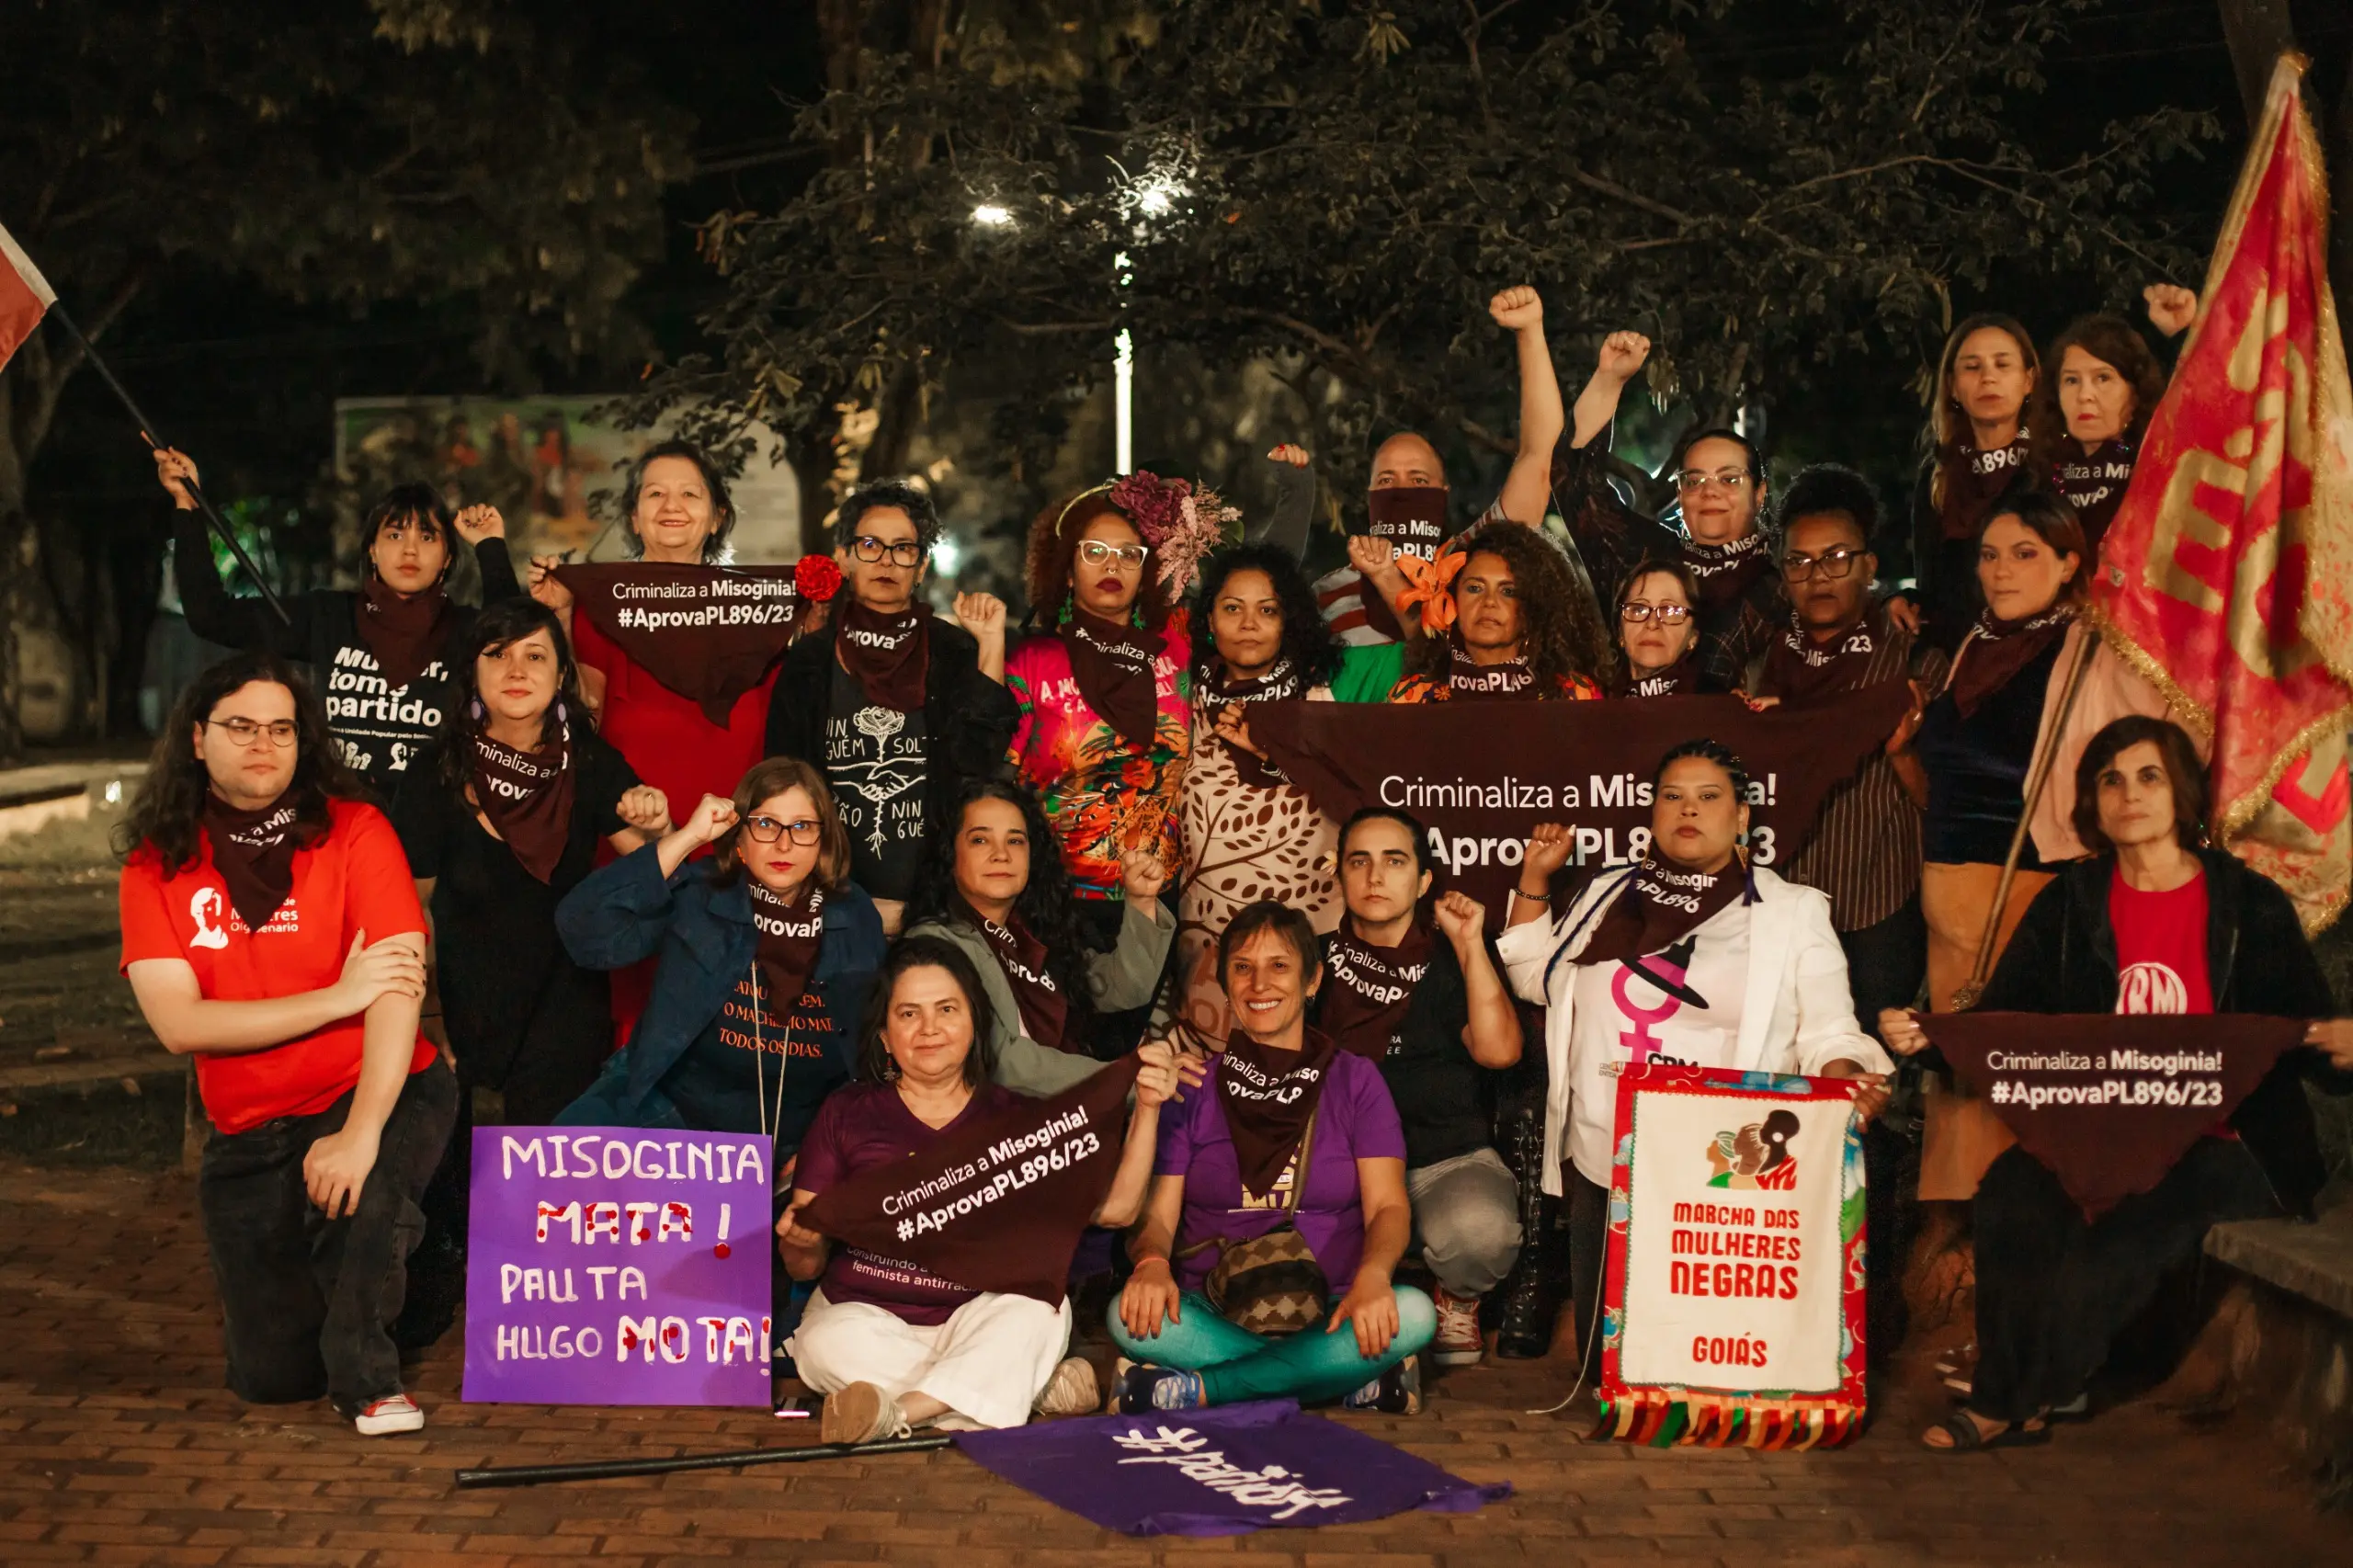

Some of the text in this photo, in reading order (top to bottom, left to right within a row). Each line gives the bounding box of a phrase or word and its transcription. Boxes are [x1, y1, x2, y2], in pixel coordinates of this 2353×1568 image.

[2105, 462, 2130, 479] Mi
[1398, 523, 1407, 534] a
[1722, 534, 1758, 555] Miso
[612, 579, 797, 600] Criminaliza a Misoginia!
[618, 604, 795, 632] #AprovaPL896/23
[326, 696, 442, 727] partido
[1380, 773, 1777, 809] Criminaliza a Misa!
[264, 808, 296, 830] Mis
[723, 1002, 734, 1017] O
[720, 1028, 766, 1051] TODOS
[1987, 1049, 2222, 1076] Criminaliza a Misoginia!
[1991, 1080, 2223, 1110] #AprovaPL896/23
[502, 1135, 765, 1185] MISOGINIA
[882, 1105, 1089, 1215] Criminaliza a Misoginia!
[896, 1131, 1100, 1242] #AprovaPL896/23
[536, 1200, 693, 1245] MATA
[1673, 1202, 1800, 1230] MARCHA DAS
[1671, 1229, 1802, 1262] MULHERES
[852, 1260, 910, 1283] feminista
[1670, 1260, 1799, 1301] NEGRAS
[496, 1314, 771, 1376] HUGO MOTA!
[1692, 1331, 1768, 1368] GOIÁS
